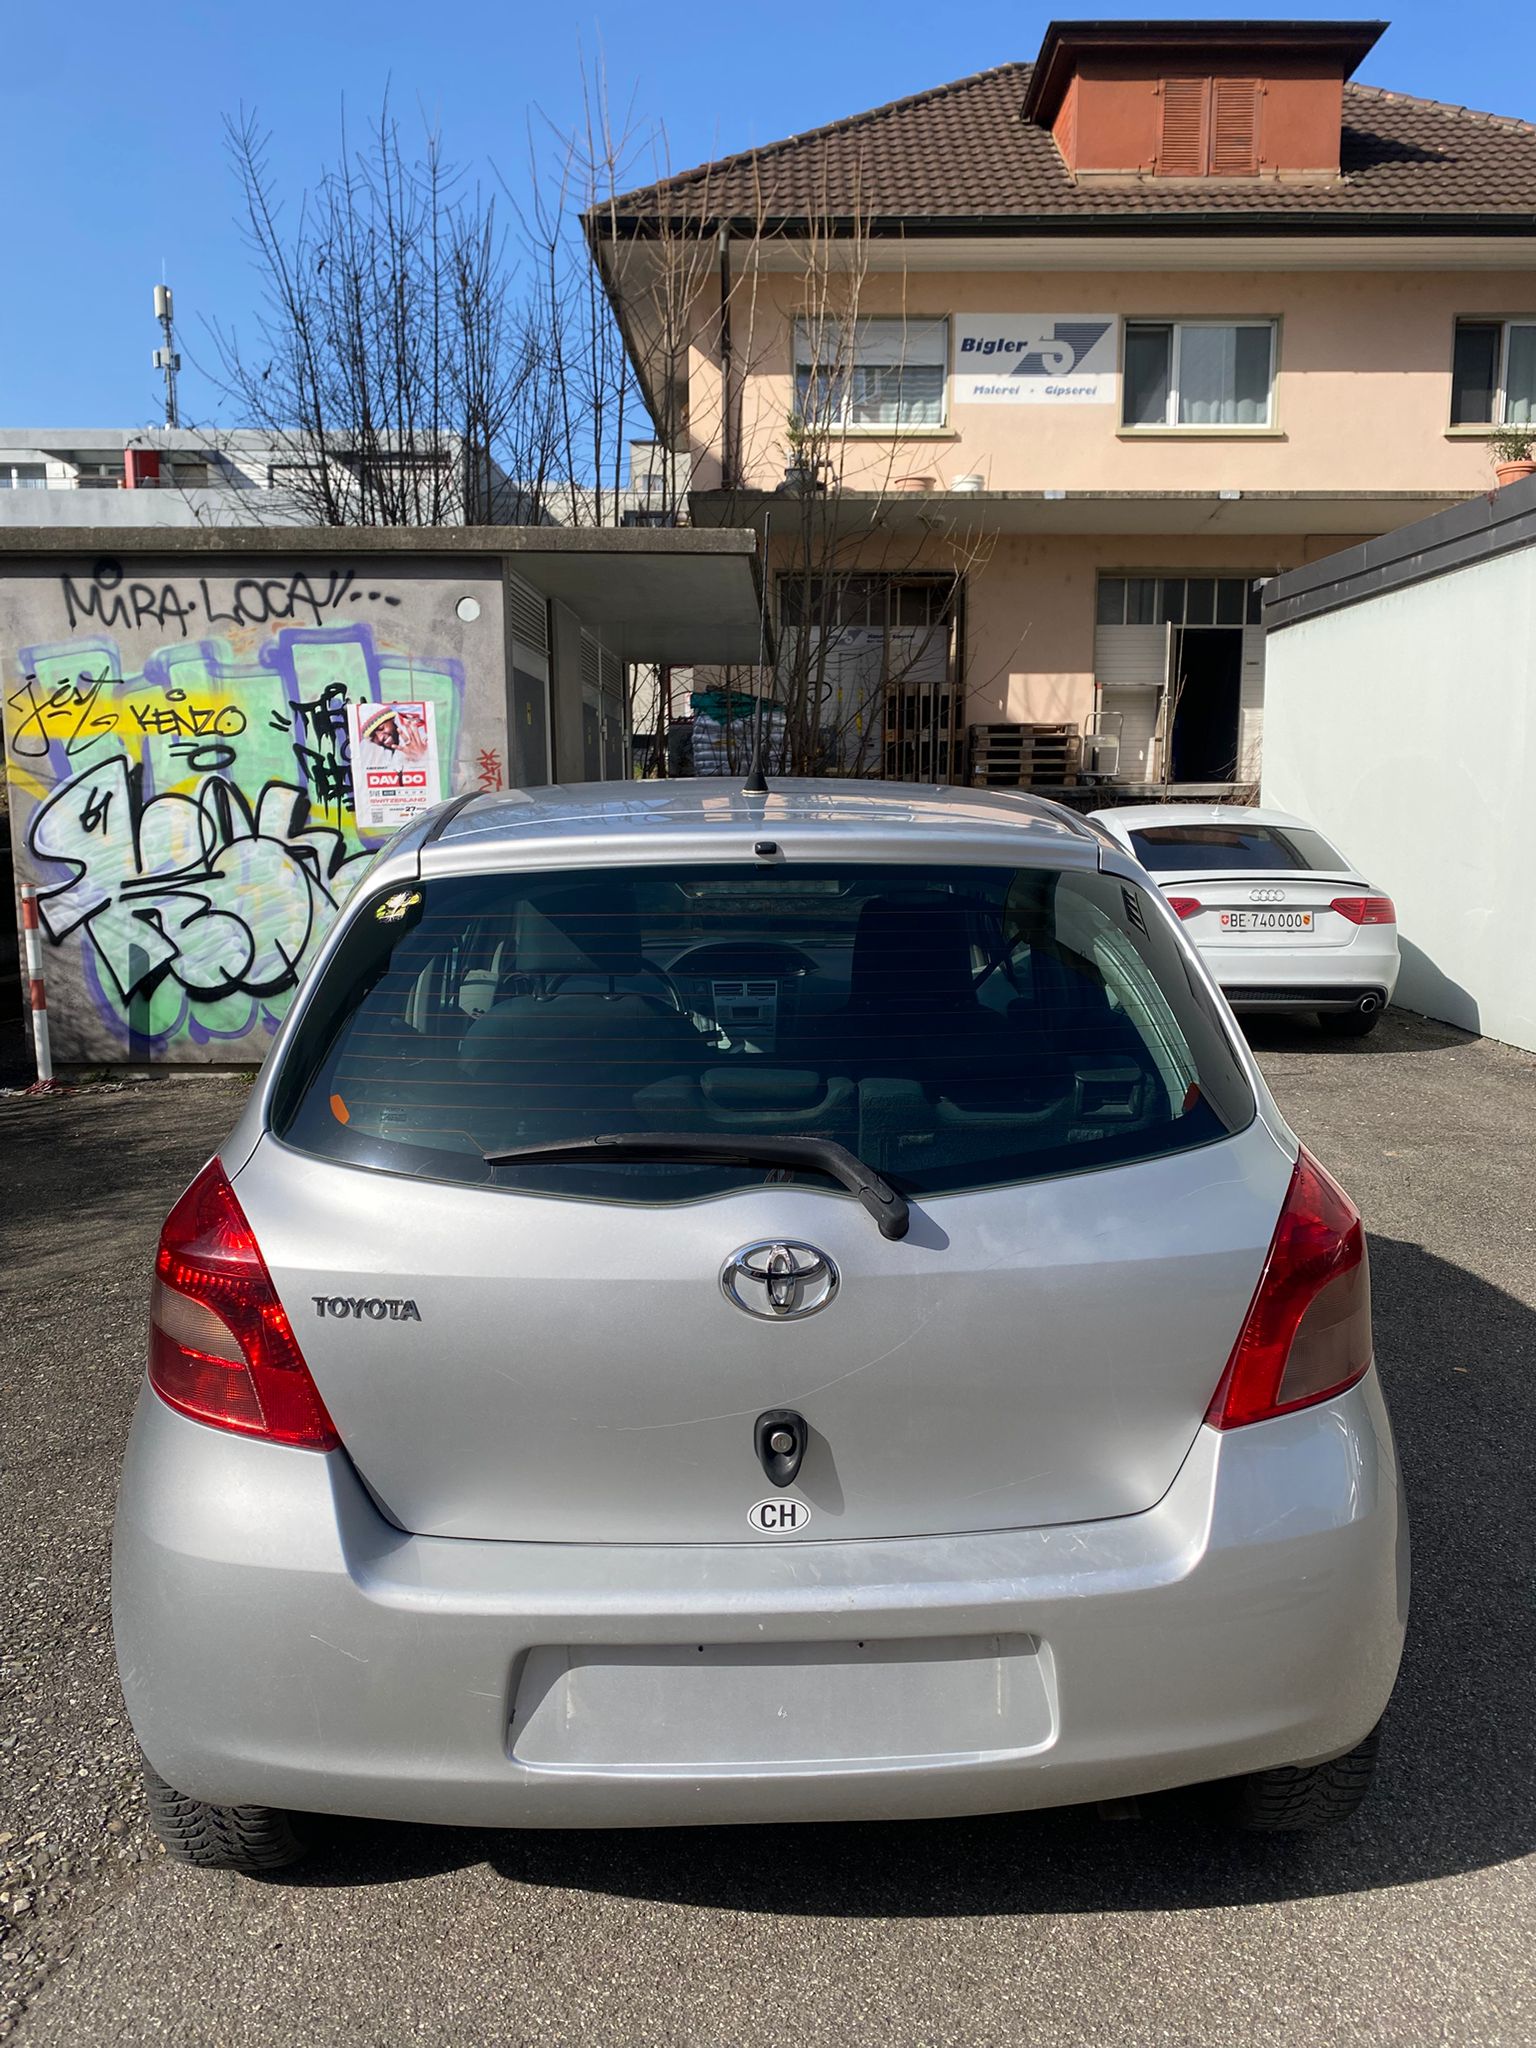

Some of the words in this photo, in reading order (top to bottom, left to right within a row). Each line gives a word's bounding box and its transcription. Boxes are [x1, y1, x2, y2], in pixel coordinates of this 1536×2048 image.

[961, 337, 1028, 355] Bigler
[973, 385, 1021, 396] Malerei
[1045, 385, 1097, 397] Gipserei
[130, 704, 247, 737] KENZO
[311, 1297, 422, 1322] TOYOTA
[760, 1504, 796, 1528] CH
